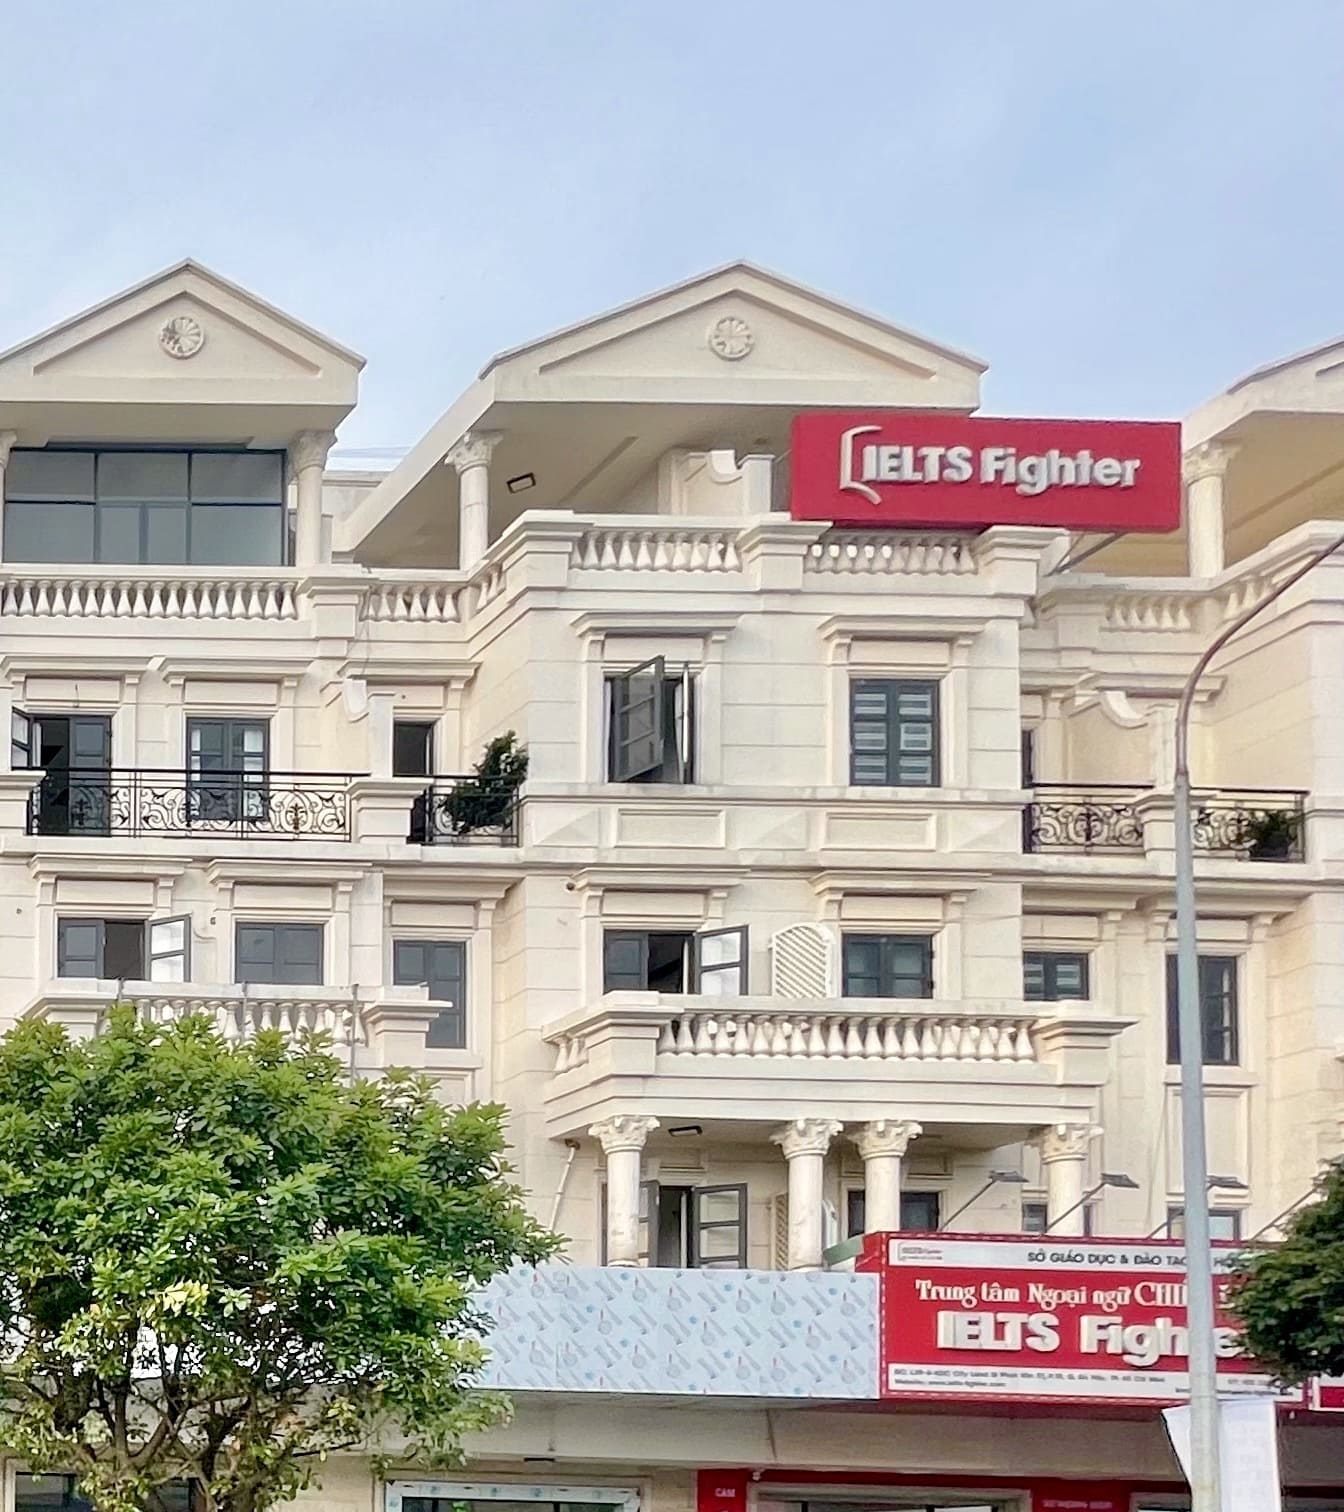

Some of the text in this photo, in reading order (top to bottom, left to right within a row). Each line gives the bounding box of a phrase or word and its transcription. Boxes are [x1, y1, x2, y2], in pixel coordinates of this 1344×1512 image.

[862, 444, 1141, 496] IELTS Fighter
[1088, 1254, 1114, 1266] DỤC
[915, 1278, 975, 1308] Trung
[981, 1281, 1020, 1303] tâm
[1027, 1282, 1087, 1310] Ngoại
[1092, 1285, 1131, 1311] ngữ
[937, 1310, 1060, 1353] IELTS
